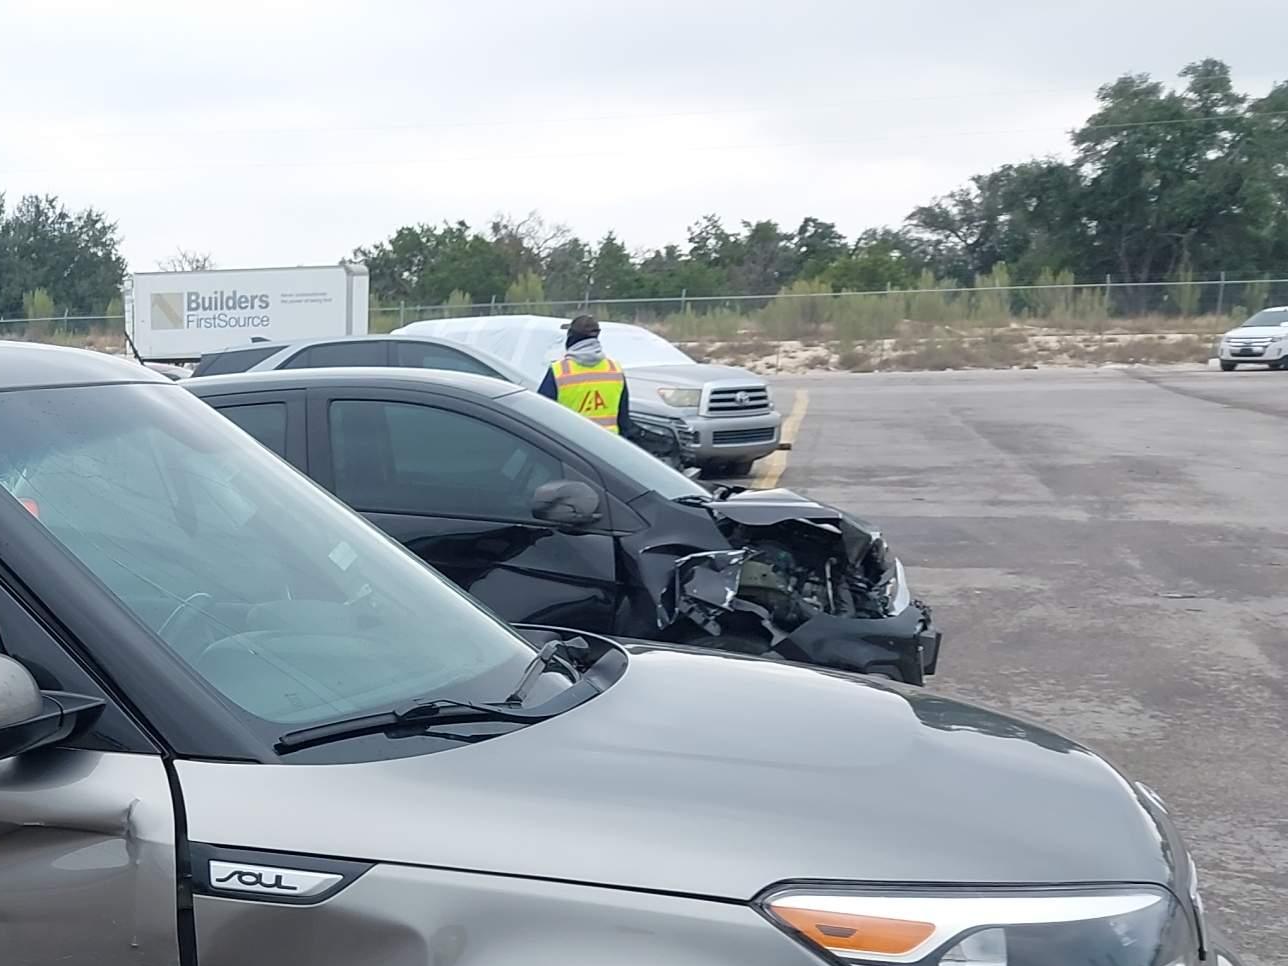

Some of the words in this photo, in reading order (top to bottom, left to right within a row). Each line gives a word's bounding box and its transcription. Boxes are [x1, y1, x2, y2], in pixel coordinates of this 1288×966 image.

[186, 290, 270, 312] Builders
[186, 313, 270, 329] FirstSource
[216, 870, 298, 891] SOUL
